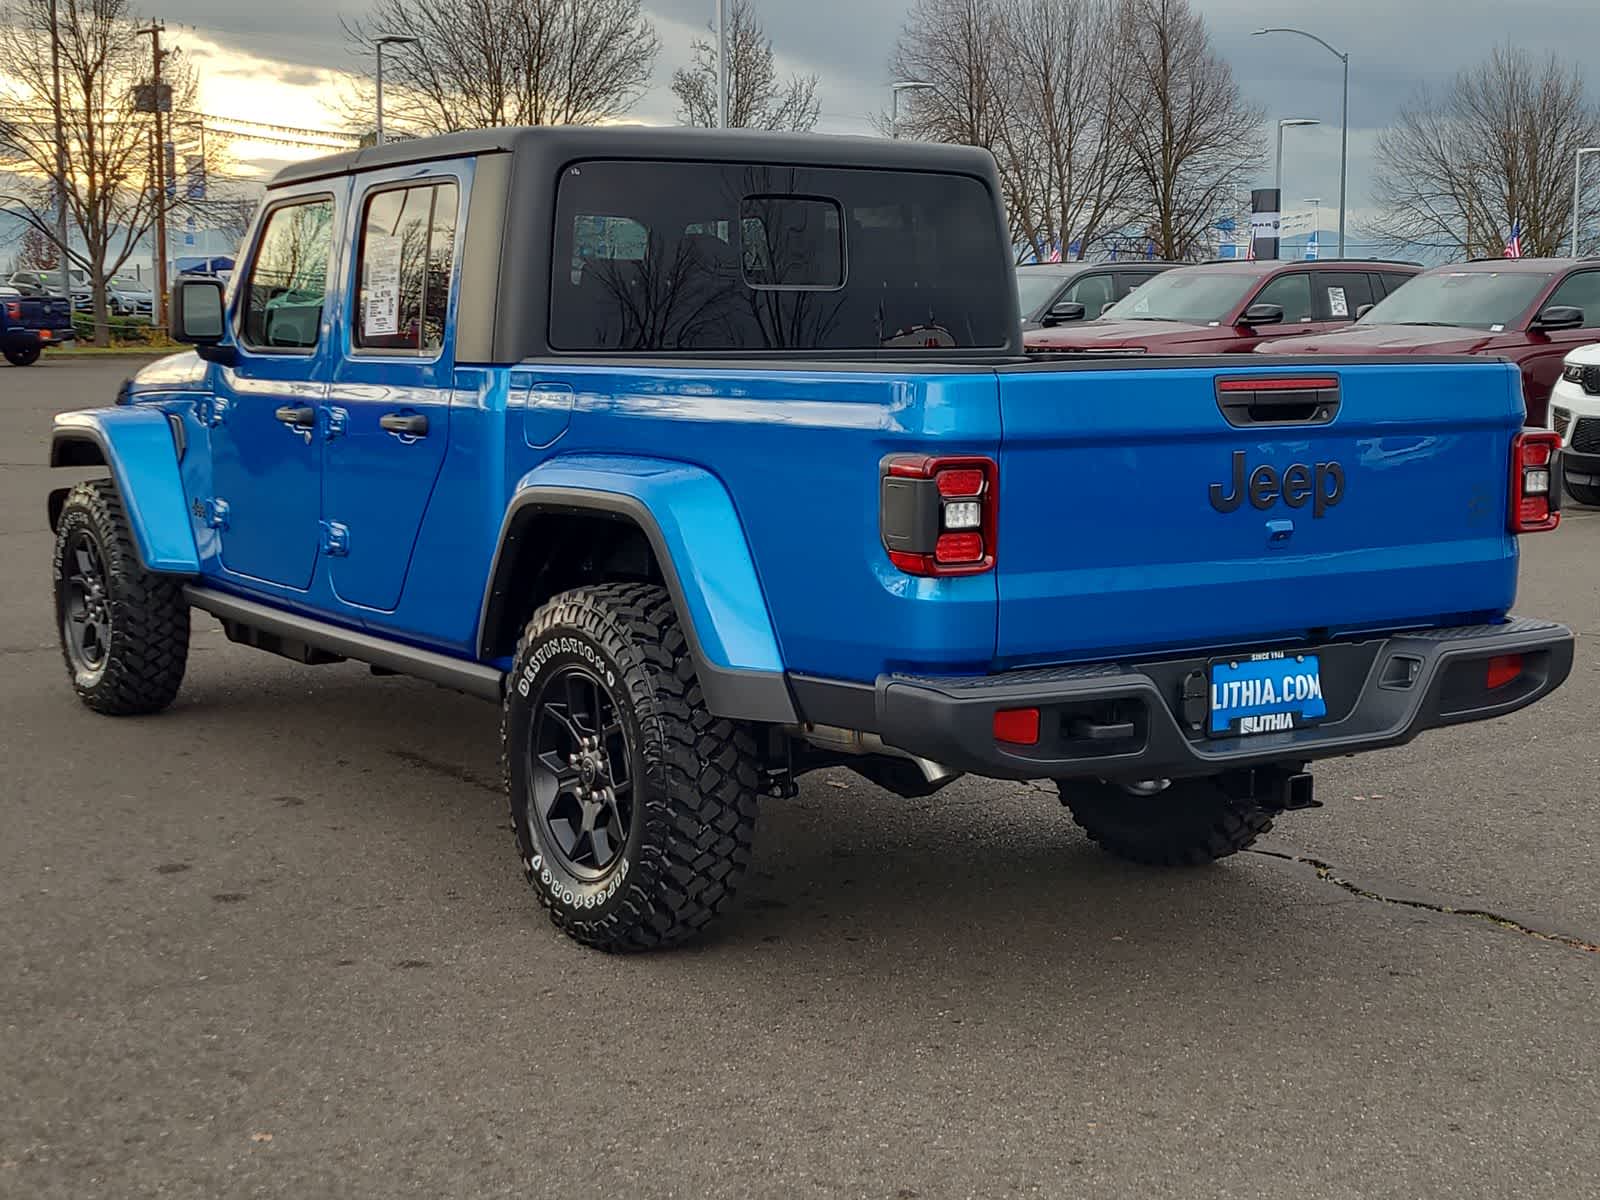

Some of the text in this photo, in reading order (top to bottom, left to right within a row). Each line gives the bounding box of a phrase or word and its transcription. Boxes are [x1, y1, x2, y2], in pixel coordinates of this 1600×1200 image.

[1208, 449, 1346, 519] Jeep
[517, 636, 605, 697] DESTINATION
[1212, 673, 1322, 710] LITHIA.COM
[1253, 712, 1294, 733] LITHIA
